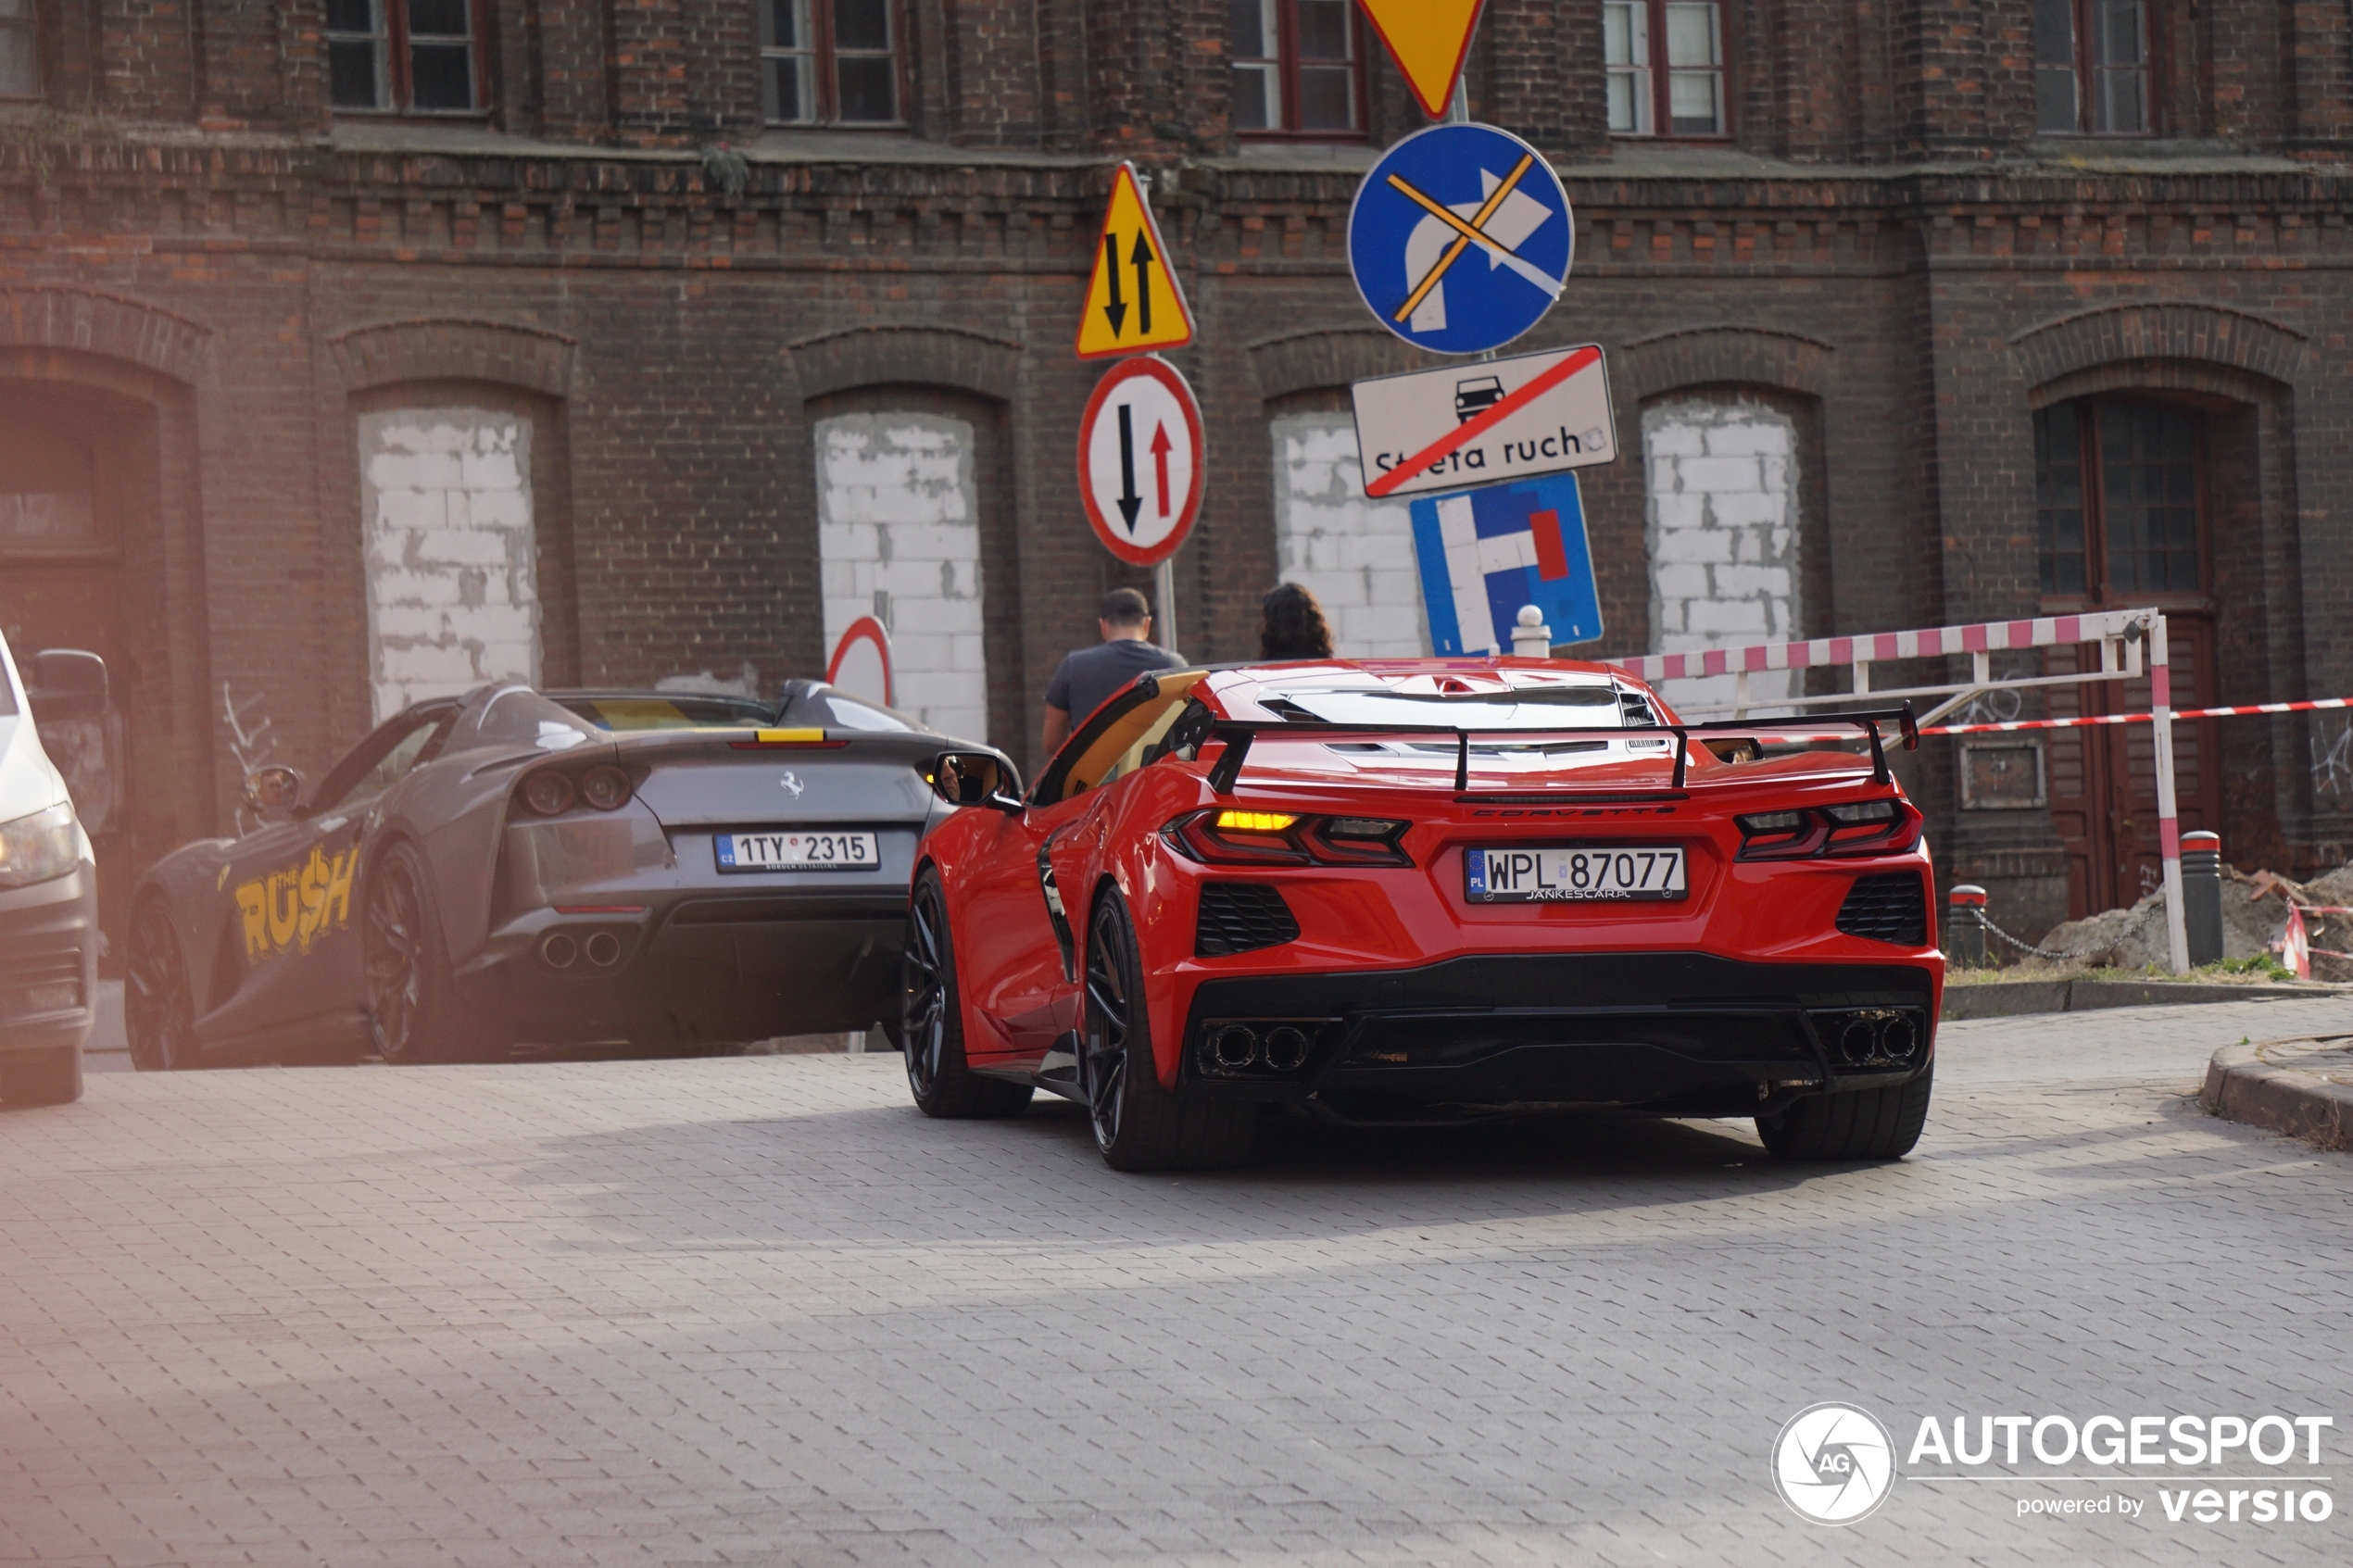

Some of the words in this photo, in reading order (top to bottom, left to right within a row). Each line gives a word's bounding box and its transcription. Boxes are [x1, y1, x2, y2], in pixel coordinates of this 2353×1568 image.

[1473, 807, 1676, 817] CORVETTE
[741, 836, 784, 862] 1TY
[806, 836, 865, 860] 2315
[721, 855, 735, 864] CZ
[1488, 853, 1557, 890] WPL
[1570, 852, 1679, 889] 87077
[279, 870, 298, 889] THE
[1470, 877, 1484, 887] PL
[1526, 888, 1631, 900] JANKESCAR.PL
